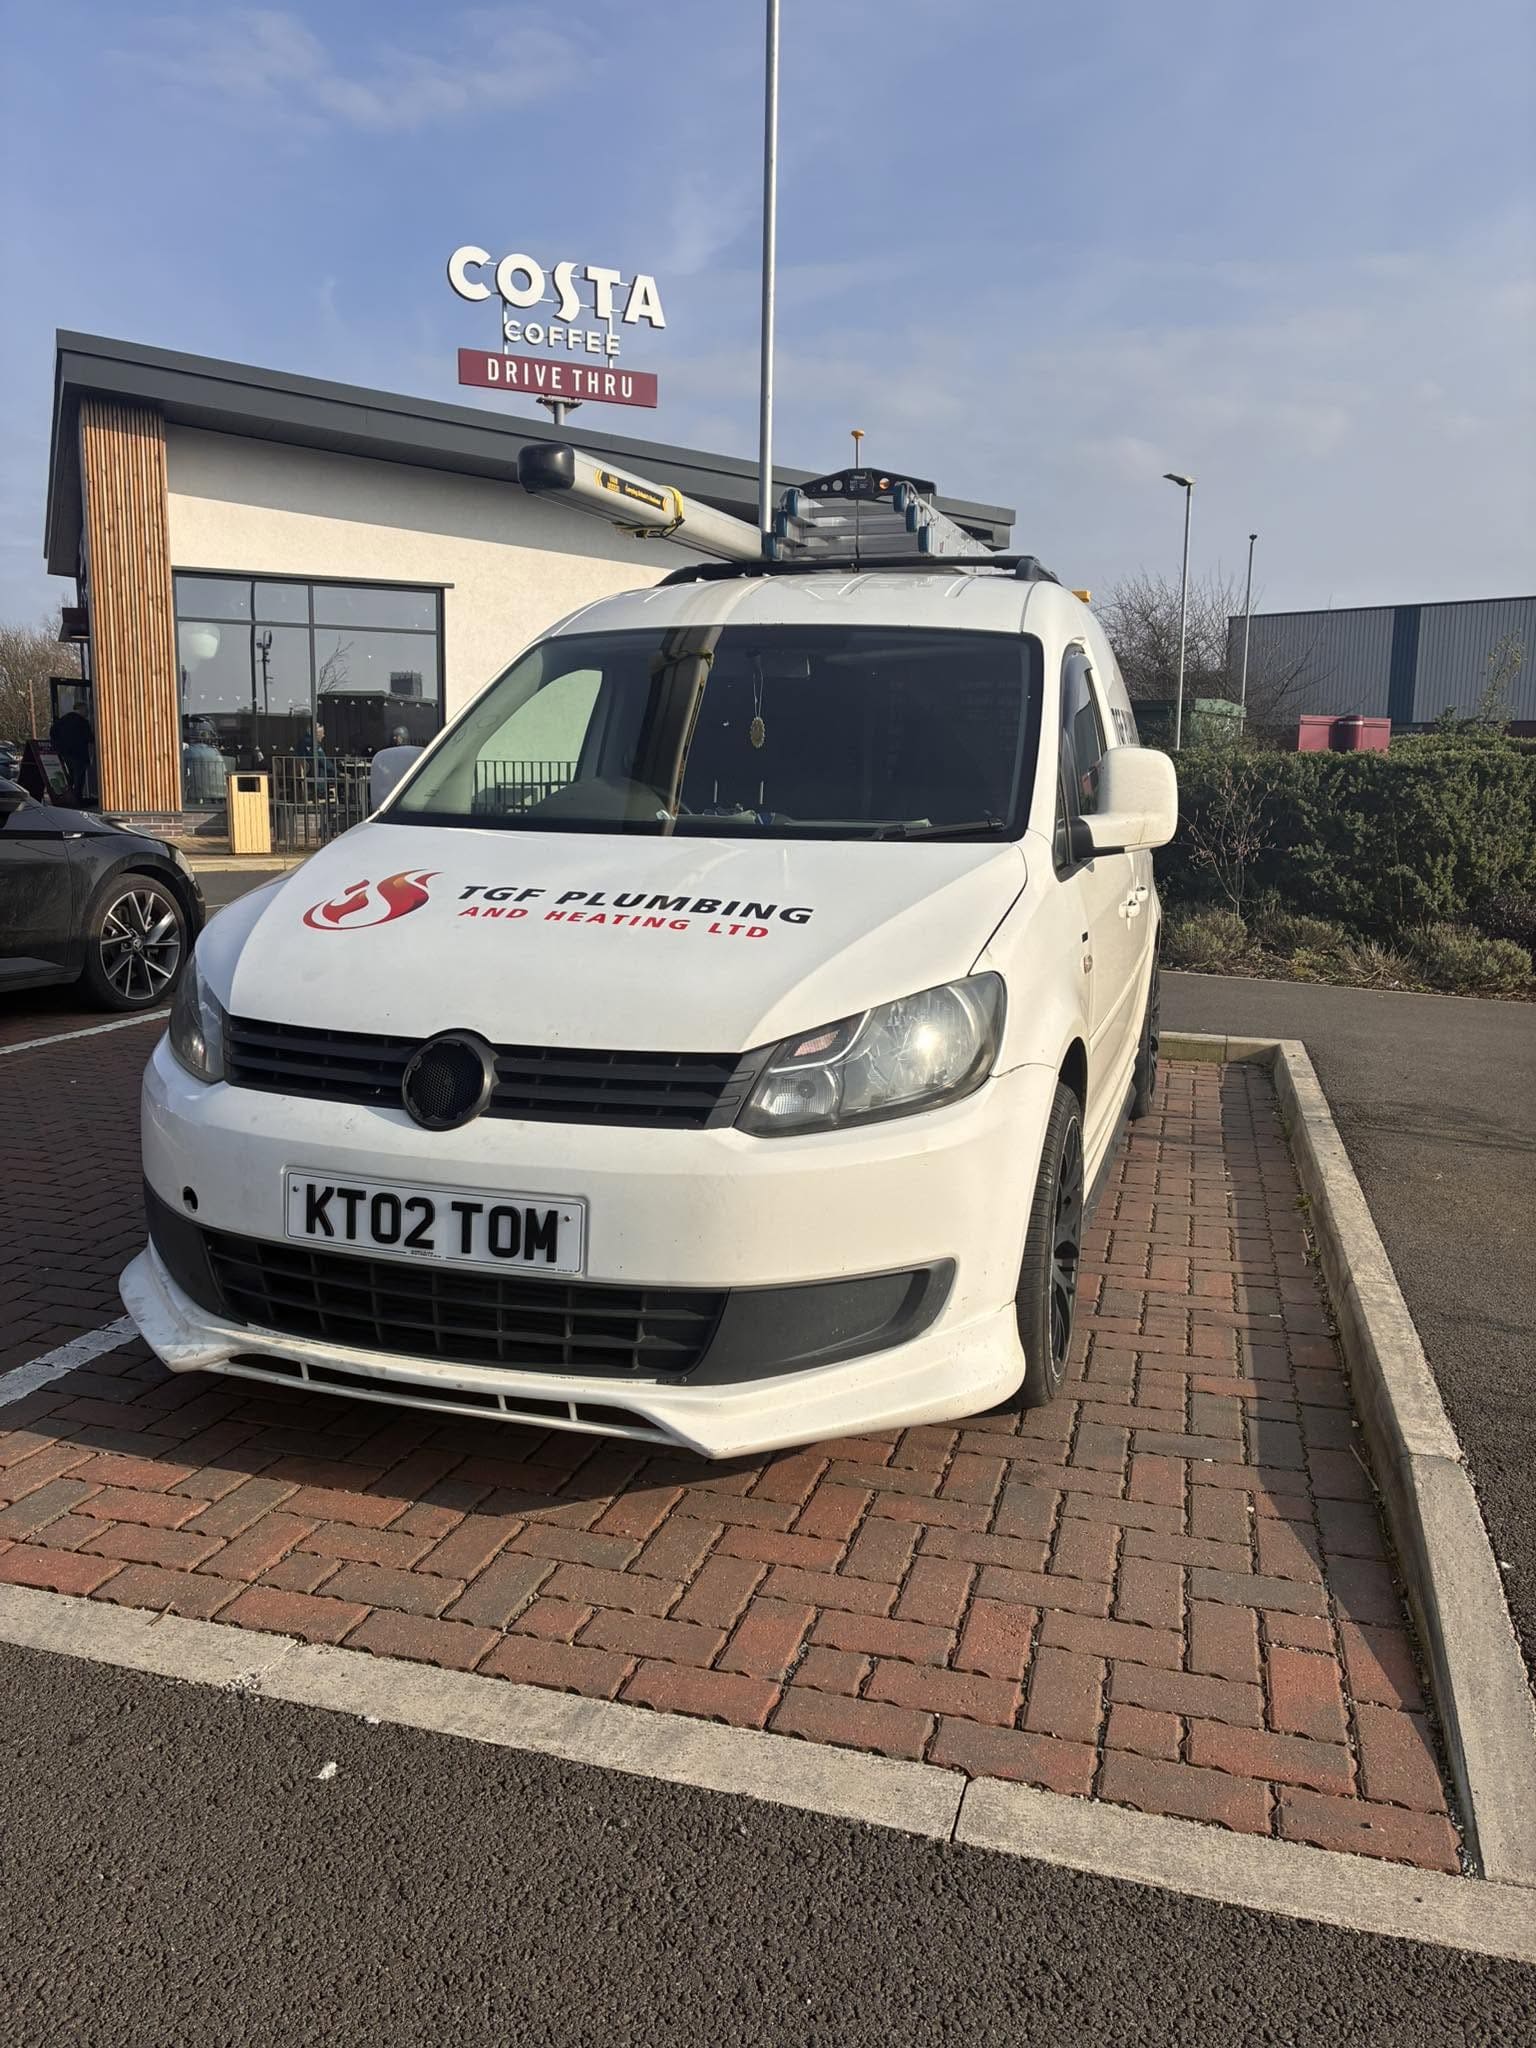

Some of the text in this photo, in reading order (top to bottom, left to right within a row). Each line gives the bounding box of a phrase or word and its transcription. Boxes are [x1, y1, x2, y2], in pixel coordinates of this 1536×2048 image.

[448, 245, 667, 329] COSTA
[504, 320, 621, 355] COFFEE
[487, 357, 633, 398] DRIVE THRU
[457, 906, 768, 938] AND HEATING LTD
[458, 885, 814, 924] TGF PLUMBING
[451, 1200, 559, 1263] TOM
